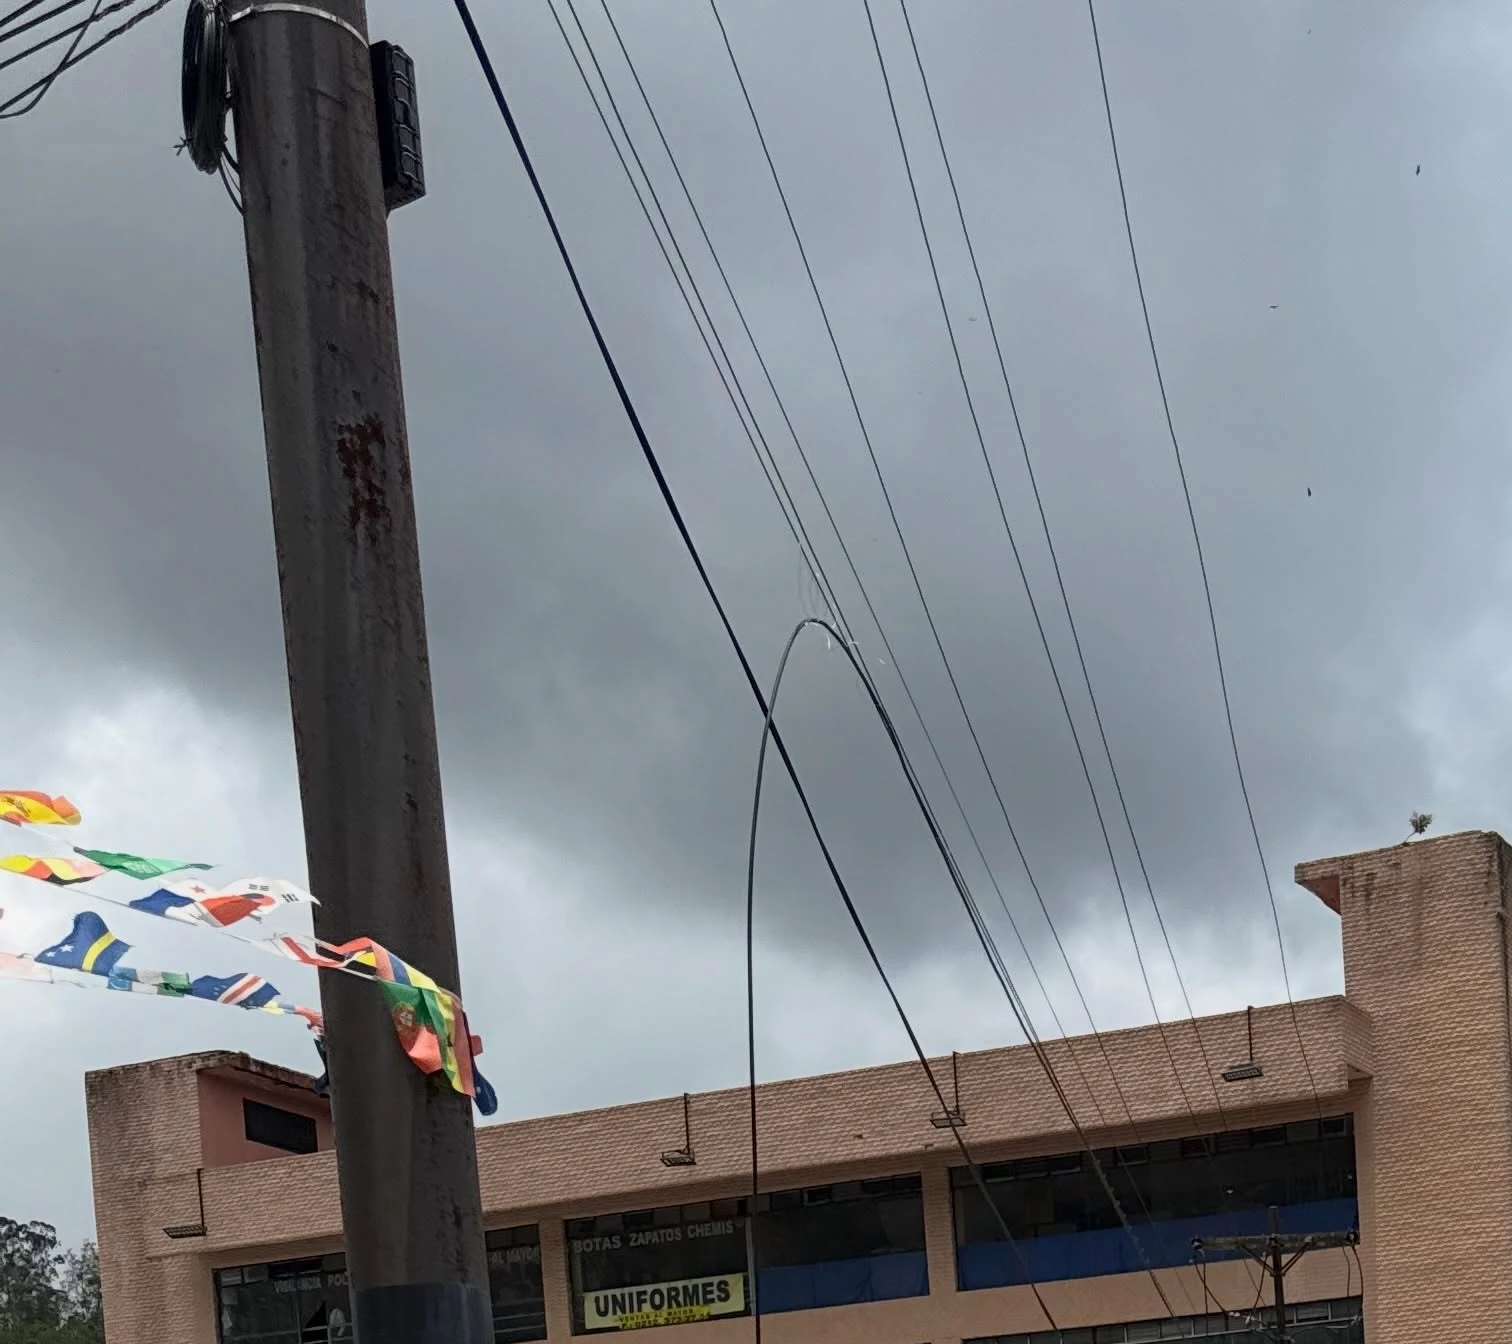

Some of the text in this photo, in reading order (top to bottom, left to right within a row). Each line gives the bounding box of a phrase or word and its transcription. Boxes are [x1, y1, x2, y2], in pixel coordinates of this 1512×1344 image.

[573, 1235, 622, 1253] BOTAS
[628, 1228, 682, 1247] ZAPATOS
[594, 1279, 731, 1317] UNIFORMES
